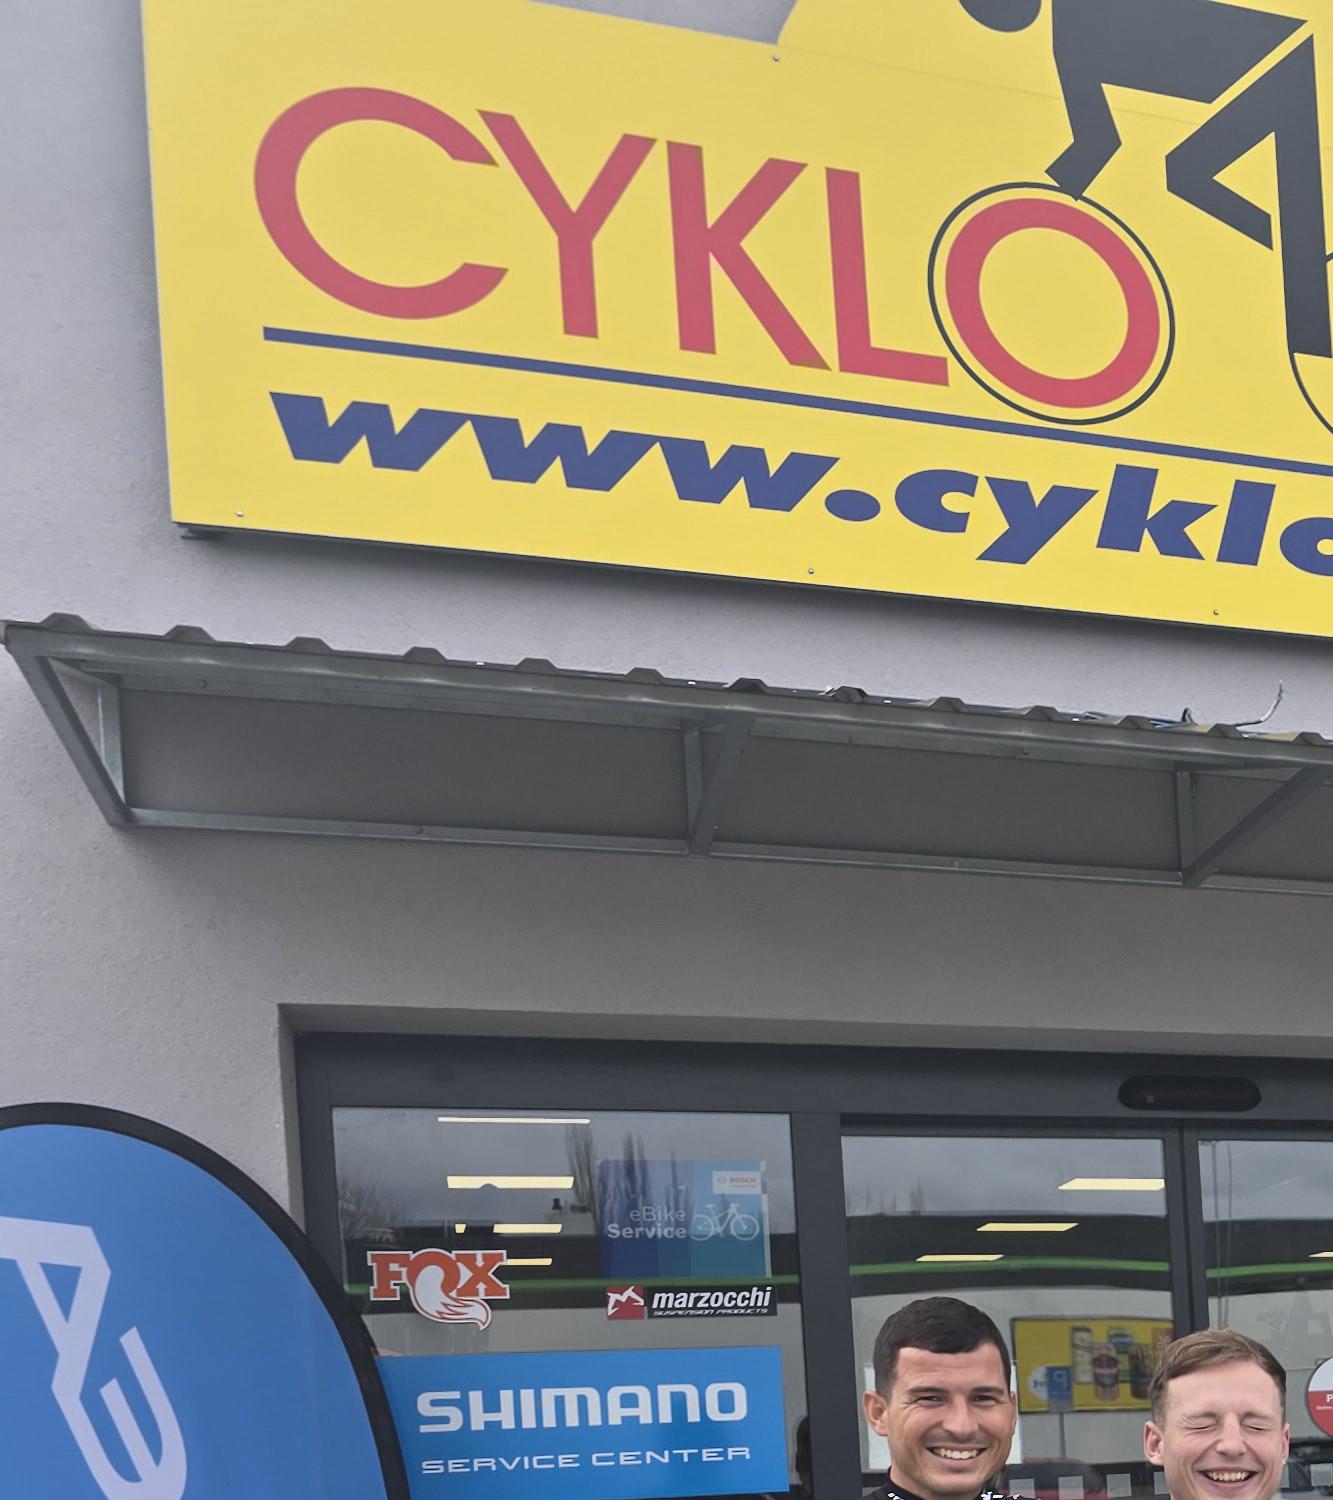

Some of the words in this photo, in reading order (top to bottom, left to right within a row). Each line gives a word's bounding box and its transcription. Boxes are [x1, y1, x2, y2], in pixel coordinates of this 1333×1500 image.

[253, 86, 1161, 410] CYKLO
[630, 1205, 687, 1221] eBike
[607, 1223, 688, 1239] Service
[367, 1249, 510, 1318] FOX
[652, 1286, 773, 1309] marzocchi
[416, 1381, 749, 1434] SHIMANO
[421, 1453, 581, 1475] SERVICE
[592, 1446, 752, 1467] CENTER
